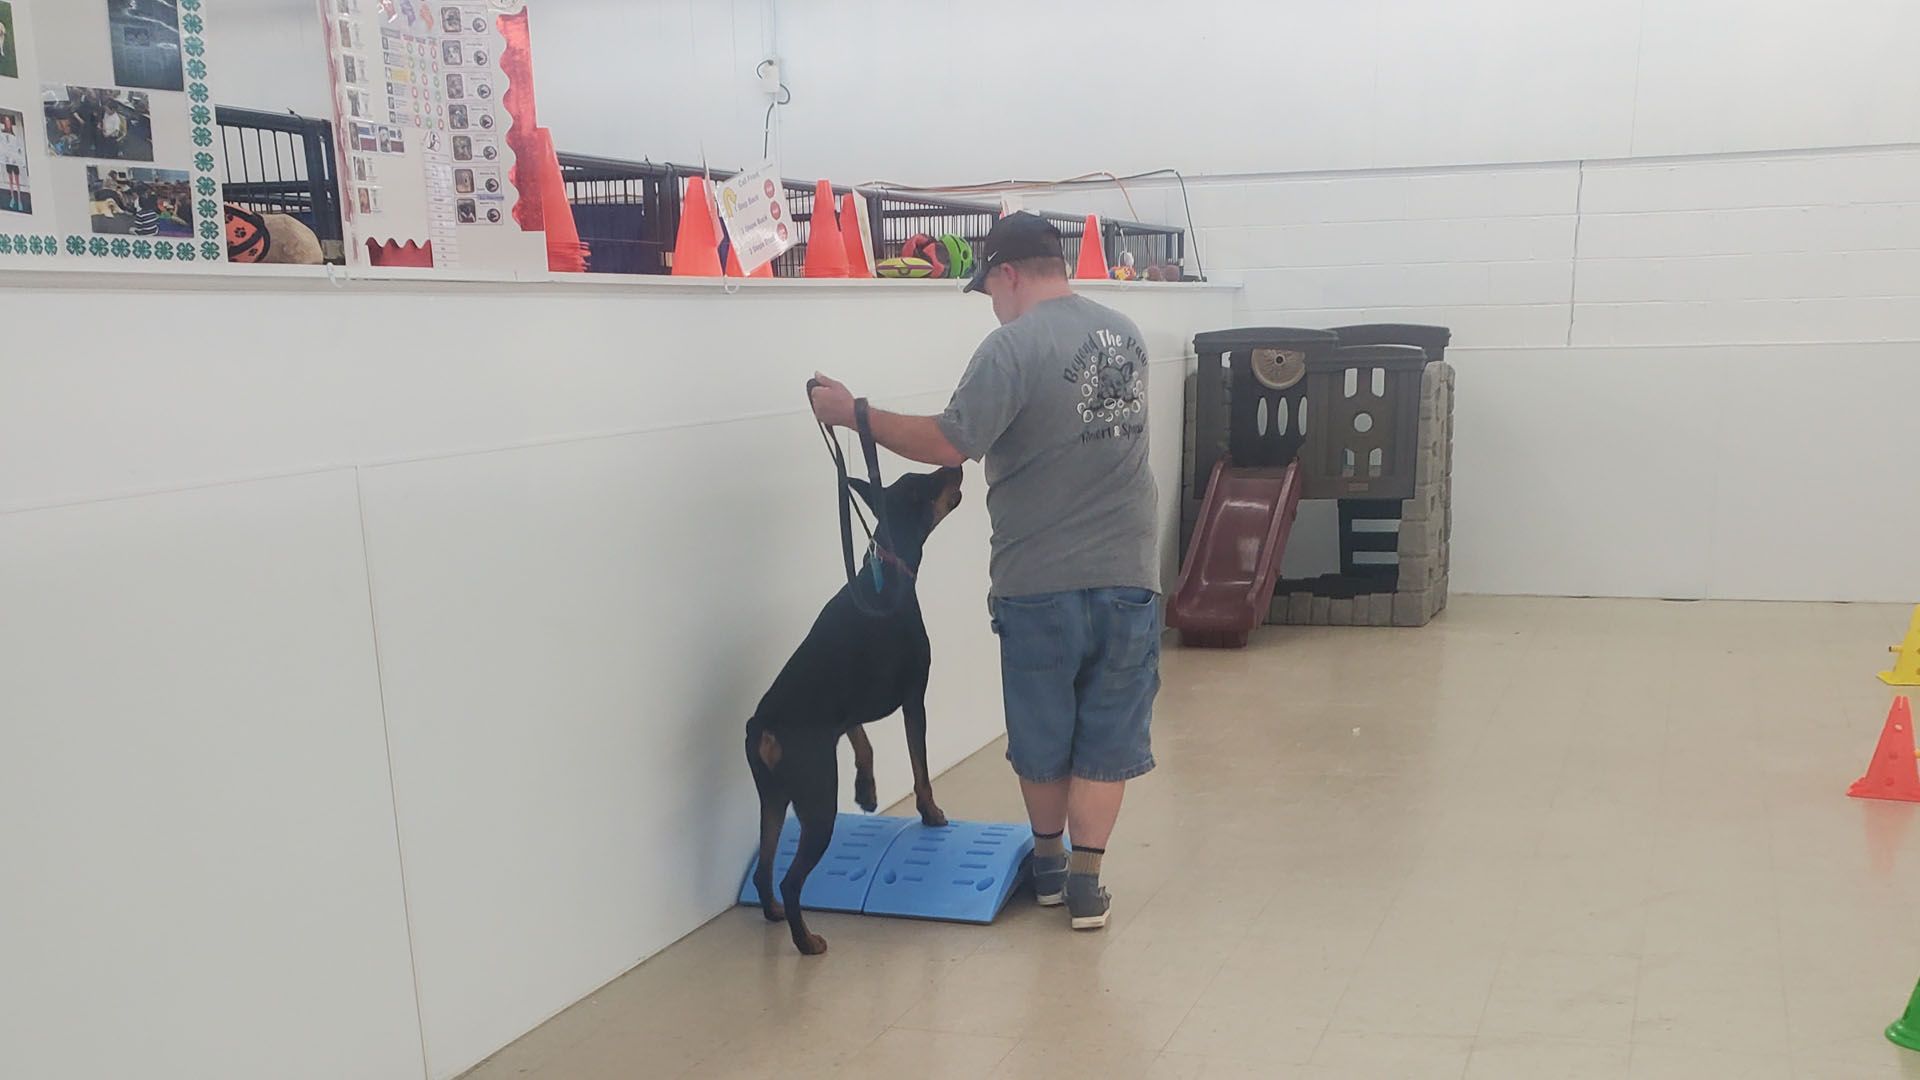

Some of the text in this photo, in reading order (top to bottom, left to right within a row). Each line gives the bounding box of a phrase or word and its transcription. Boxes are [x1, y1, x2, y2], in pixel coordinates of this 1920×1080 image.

[1063, 328, 1148, 384] Beyond The Paw
[1114, 425, 1121, 438] &
